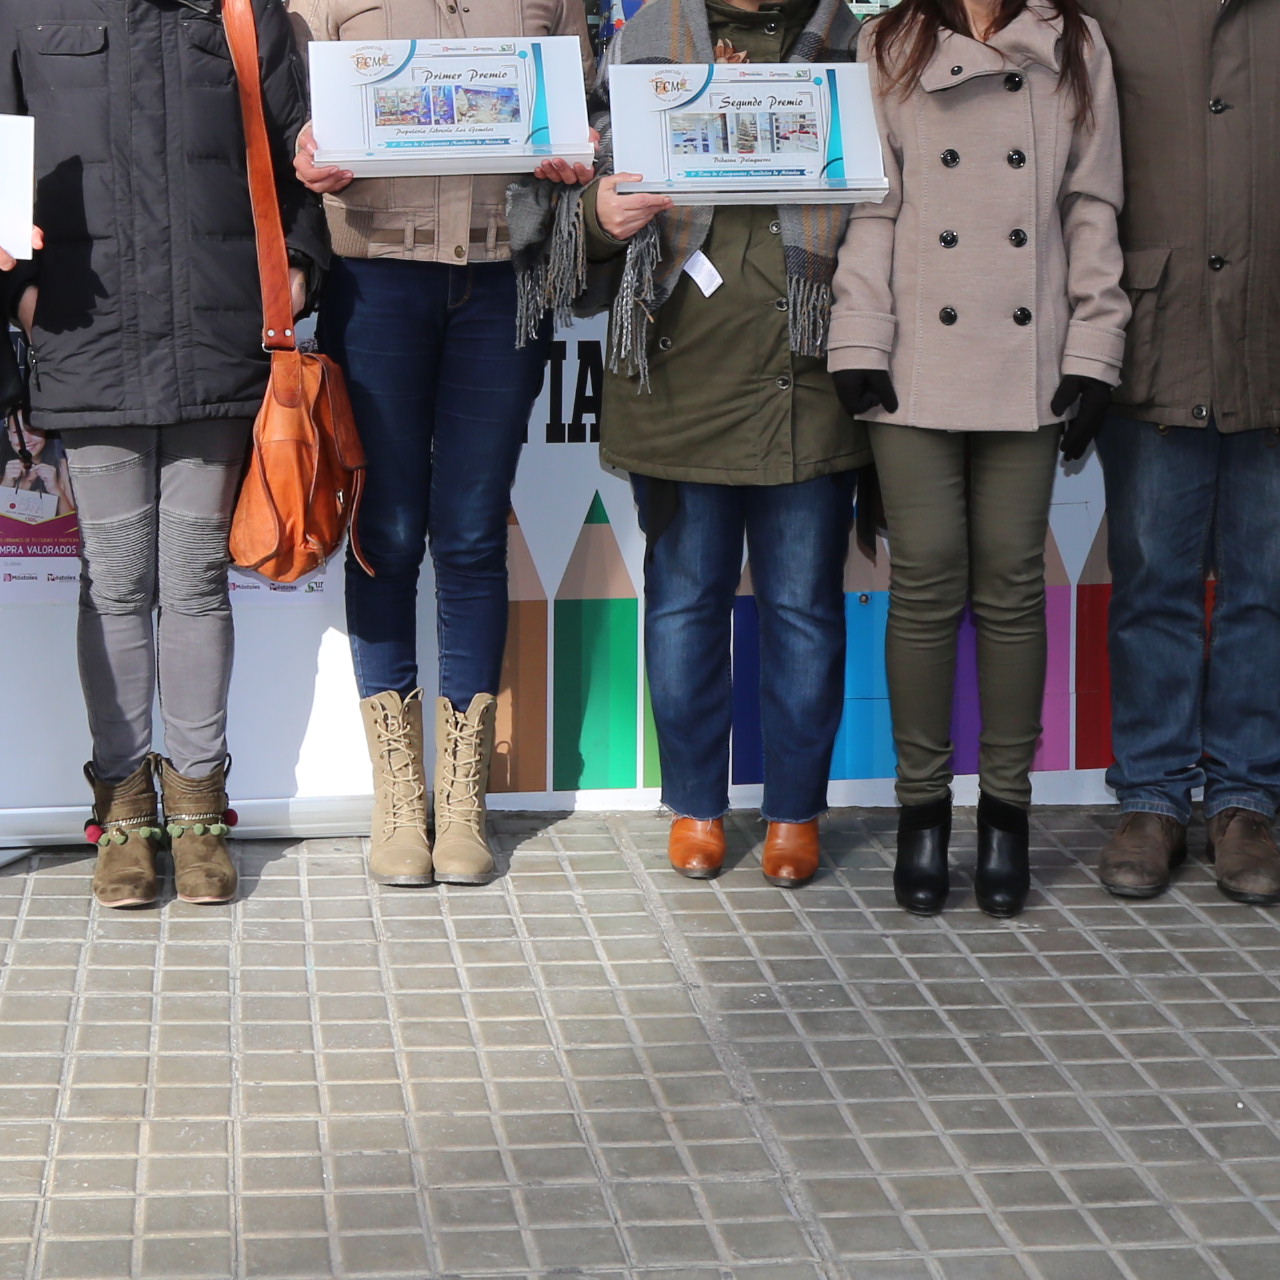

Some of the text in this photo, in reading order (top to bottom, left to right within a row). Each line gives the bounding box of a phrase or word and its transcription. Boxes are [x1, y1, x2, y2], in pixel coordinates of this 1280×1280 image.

[421, 68, 508, 83] Primer Premio
[719, 95, 804, 110] Segundo Premio
[27, 545, 77, 554] VALORADOS
